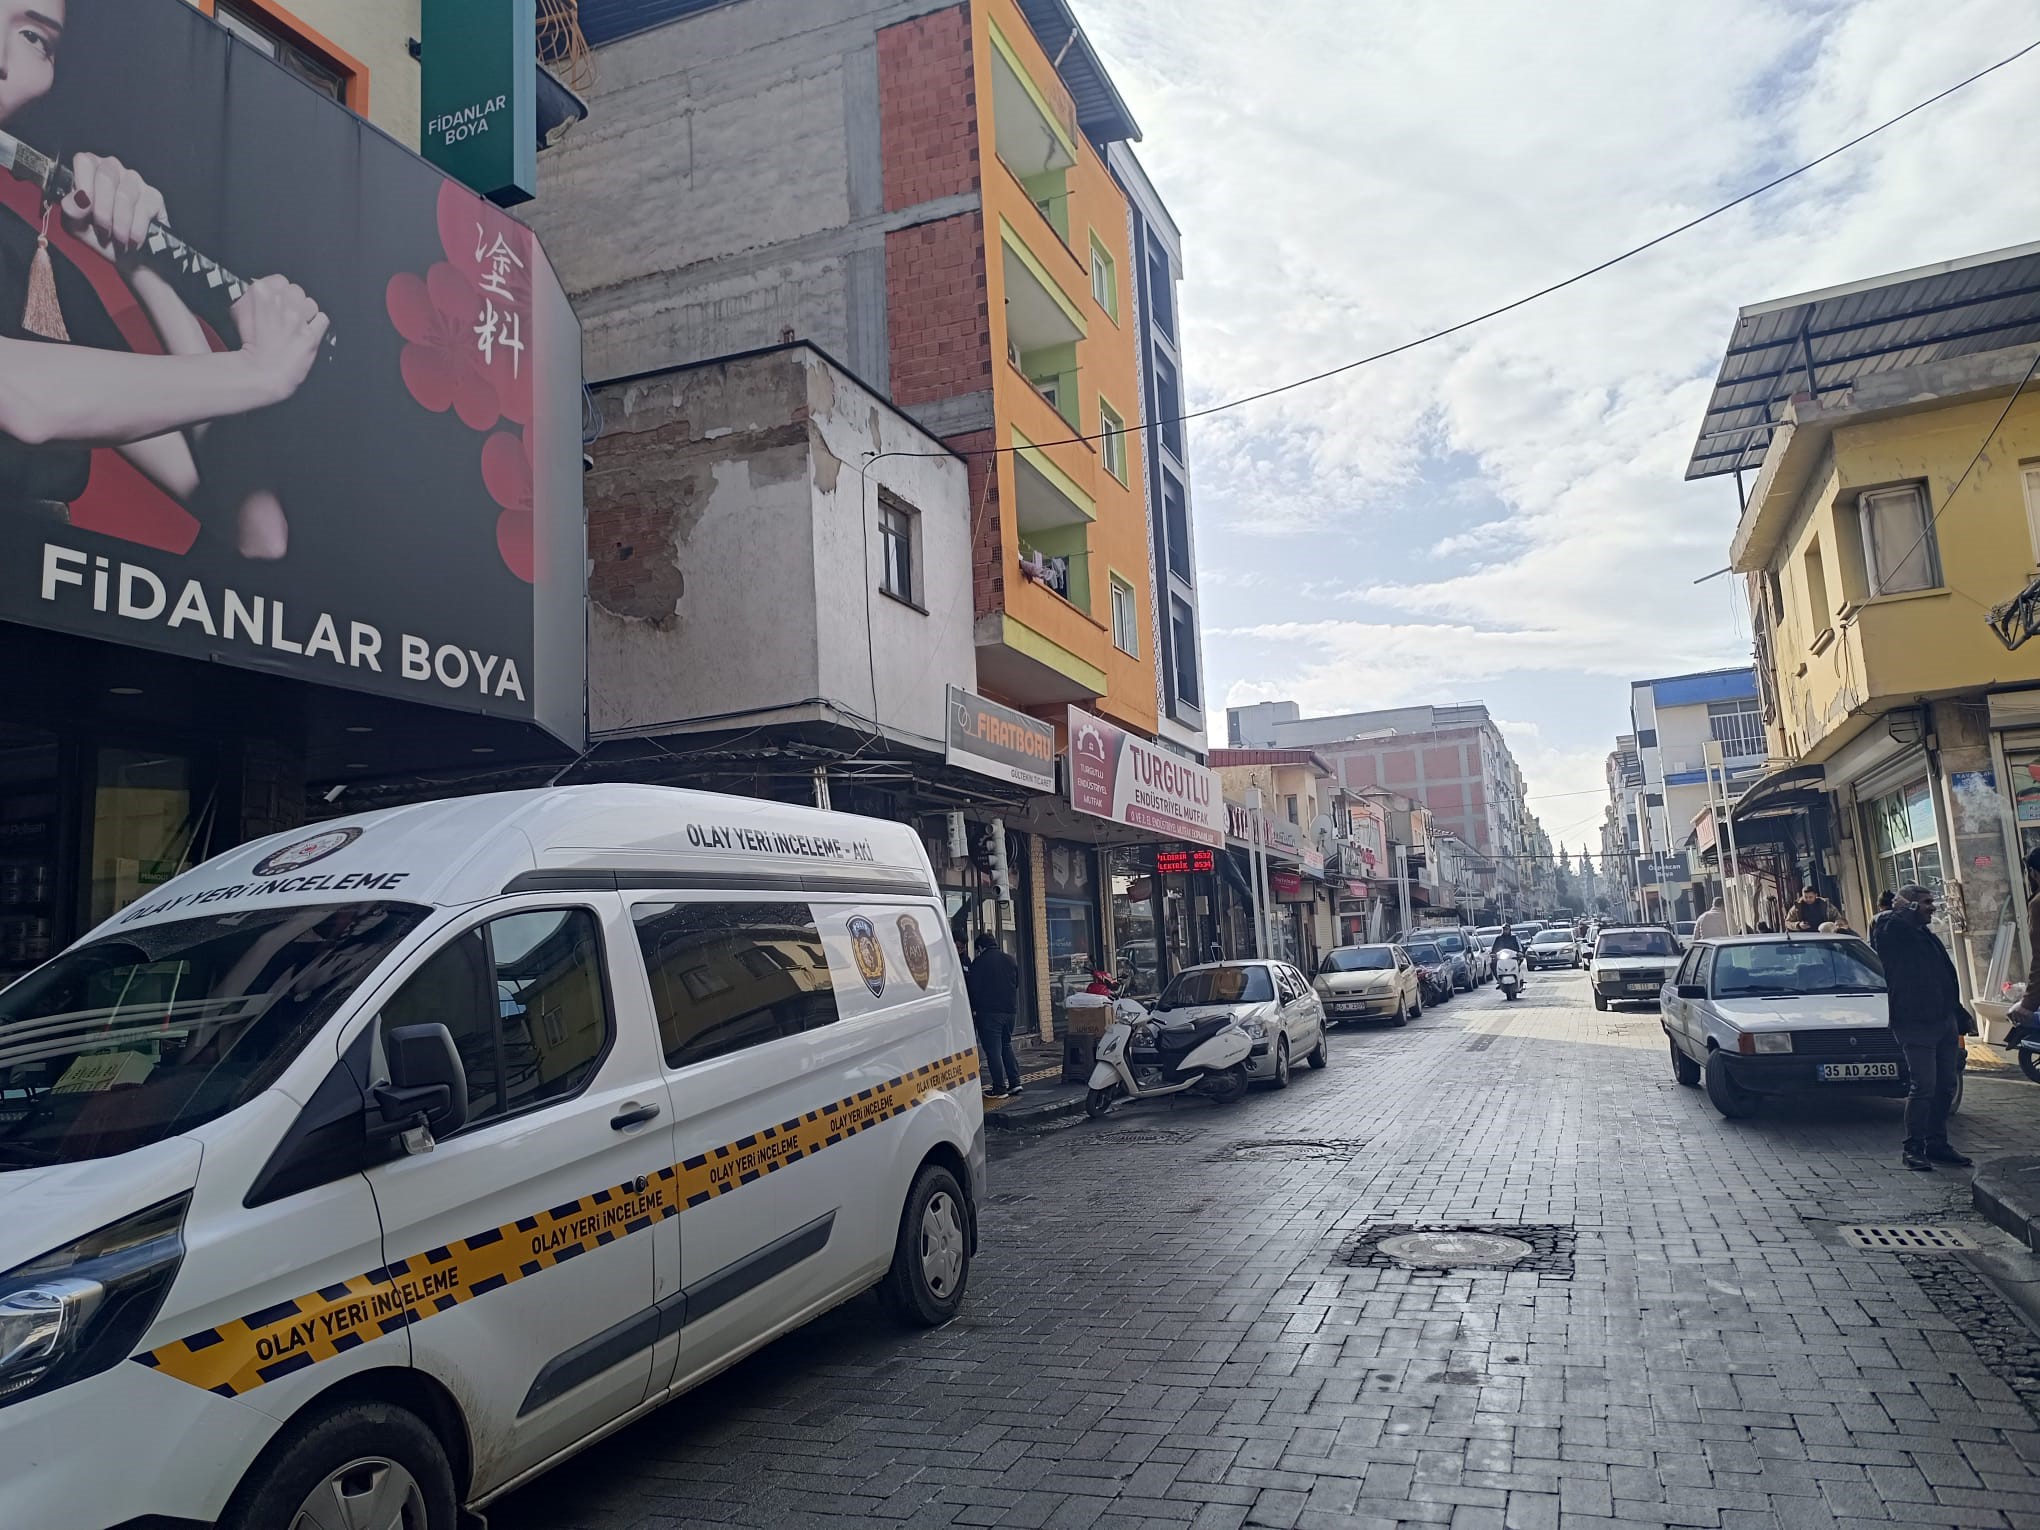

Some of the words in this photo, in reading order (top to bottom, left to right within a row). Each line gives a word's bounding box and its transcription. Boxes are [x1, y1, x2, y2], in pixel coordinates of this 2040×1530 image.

[445, 117, 489, 145] BOYA
[401, 634, 525, 703] BOYA
[1130, 745, 1210, 807] TURGUTLU
[1135, 789, 1183, 818] ENDÜSTRİYEL
[1183, 805, 1209, 826] MUTFAK
[686, 823, 731, 848] OLAY
[733, 828, 771, 852] YERİ
[120, 896, 189, 925] OLAY
[1826, 1066, 1839, 1076] 35
[1845, 1065, 1859, 1076] AD
[1864, 1064, 1895, 1075] 2368
[916, 1080, 930, 1094] OLAY
[830, 1115, 848, 1133] OLAY
[710, 1162, 733, 1184] OLAY
[531, 1226, 568, 1256] OLAY
[255, 1321, 316, 1361] OLAY
